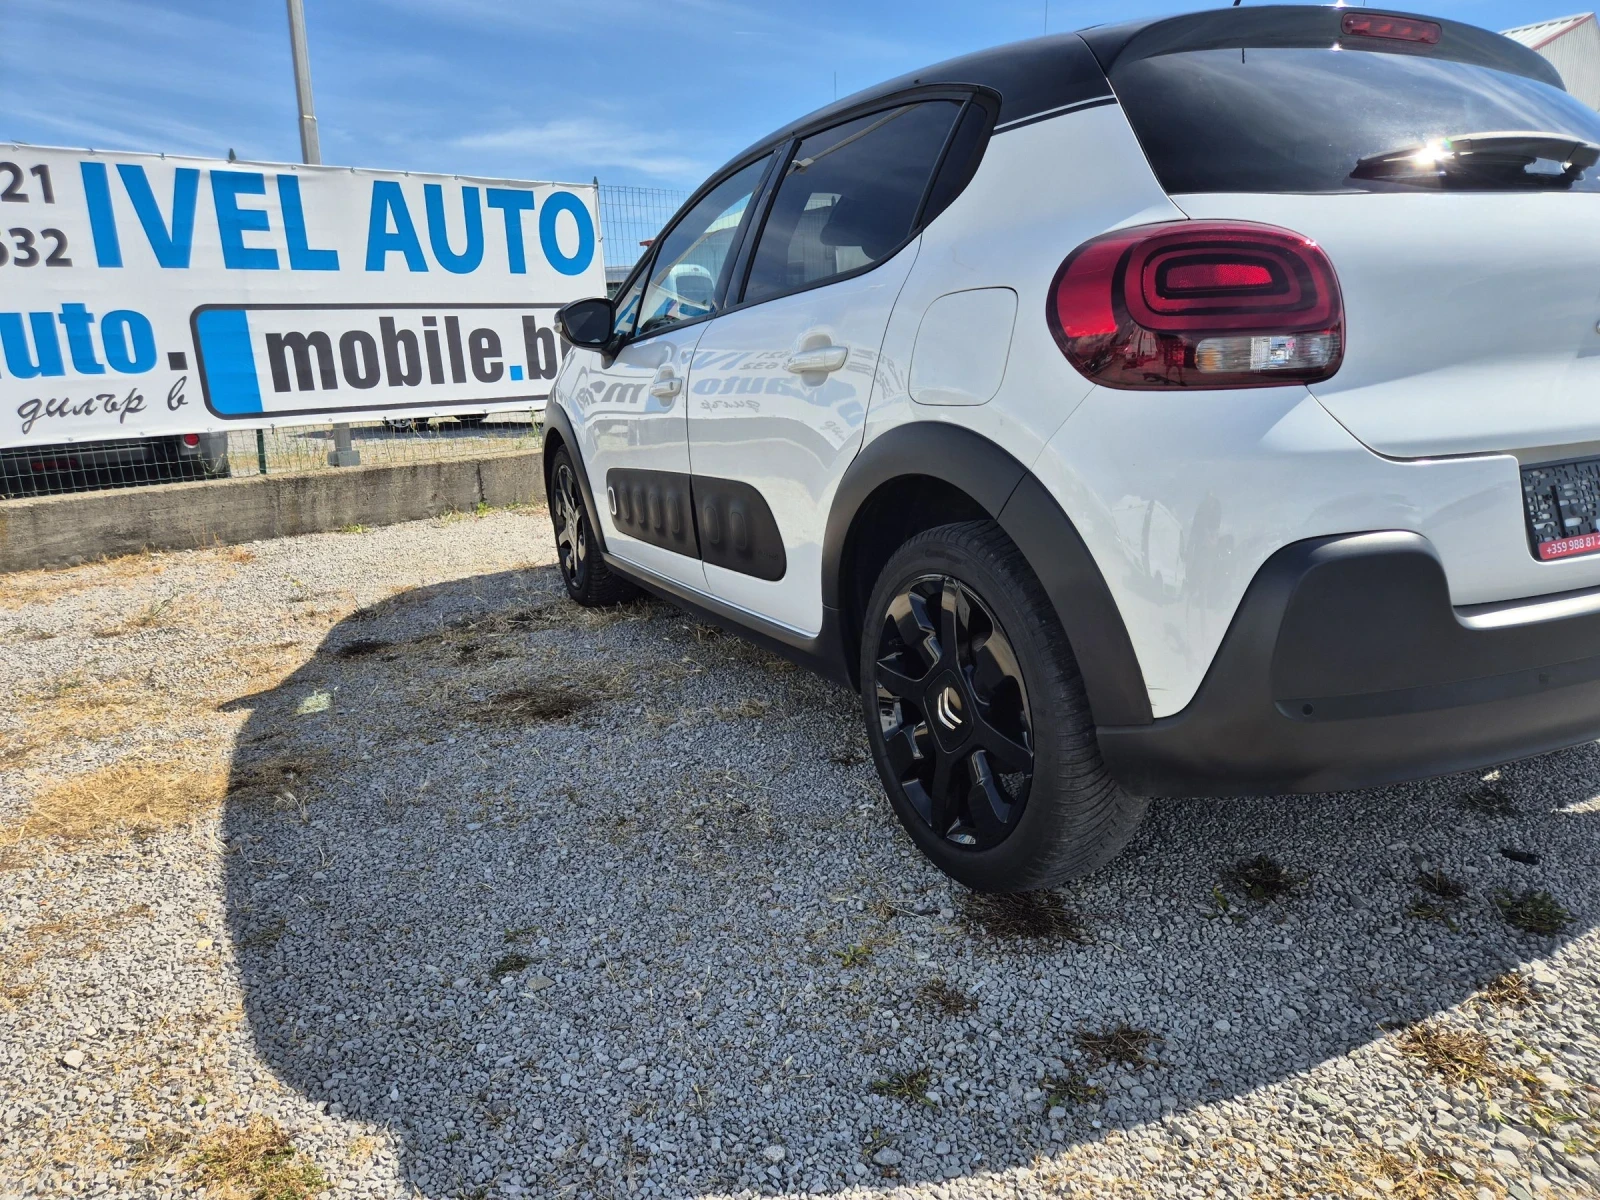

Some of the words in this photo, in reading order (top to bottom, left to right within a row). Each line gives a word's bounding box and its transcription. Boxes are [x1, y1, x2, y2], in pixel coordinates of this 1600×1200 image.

[80, 161, 340, 271] IVEL
[365, 180, 594, 277] AUTO
[17, 387, 147, 435] дилър
[1546, 541, 1567, 554] +359
[1568, 538, 1585, 551] 988
[1585, 535, 1596, 547] 81
